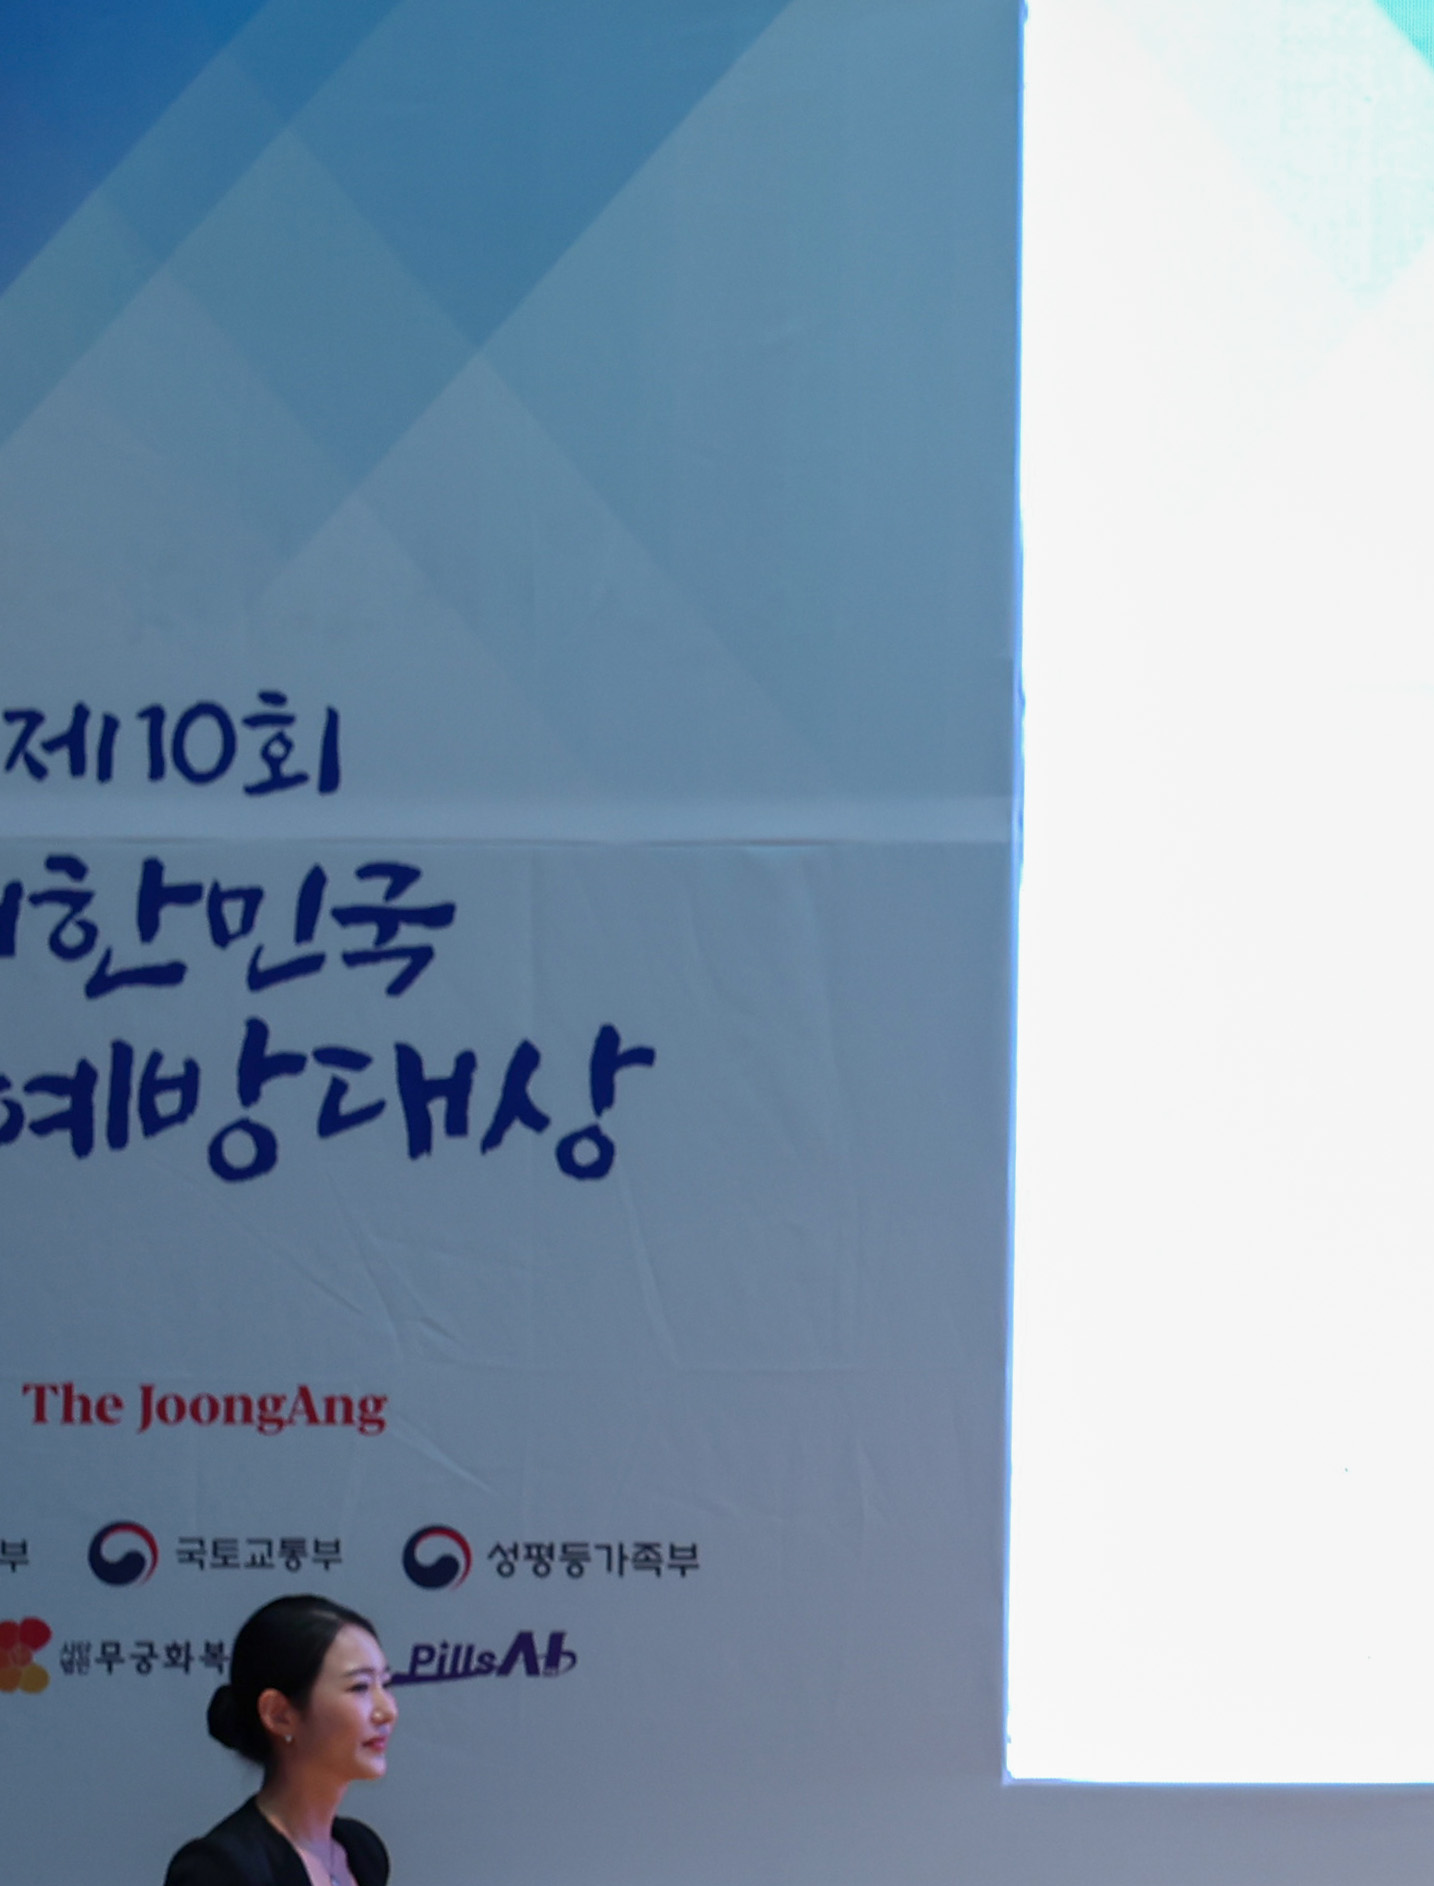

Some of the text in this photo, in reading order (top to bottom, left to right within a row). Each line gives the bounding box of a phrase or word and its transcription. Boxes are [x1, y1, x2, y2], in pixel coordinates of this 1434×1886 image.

[3, 690, 341, 797] 제10회
[0, 854, 457, 1000] 한민국
[23, 1382, 388, 1435] The JoongAng
[177, 1538, 342, 1572] 국토교통부
[487, 1541, 699, 1579] 성평등가족부
